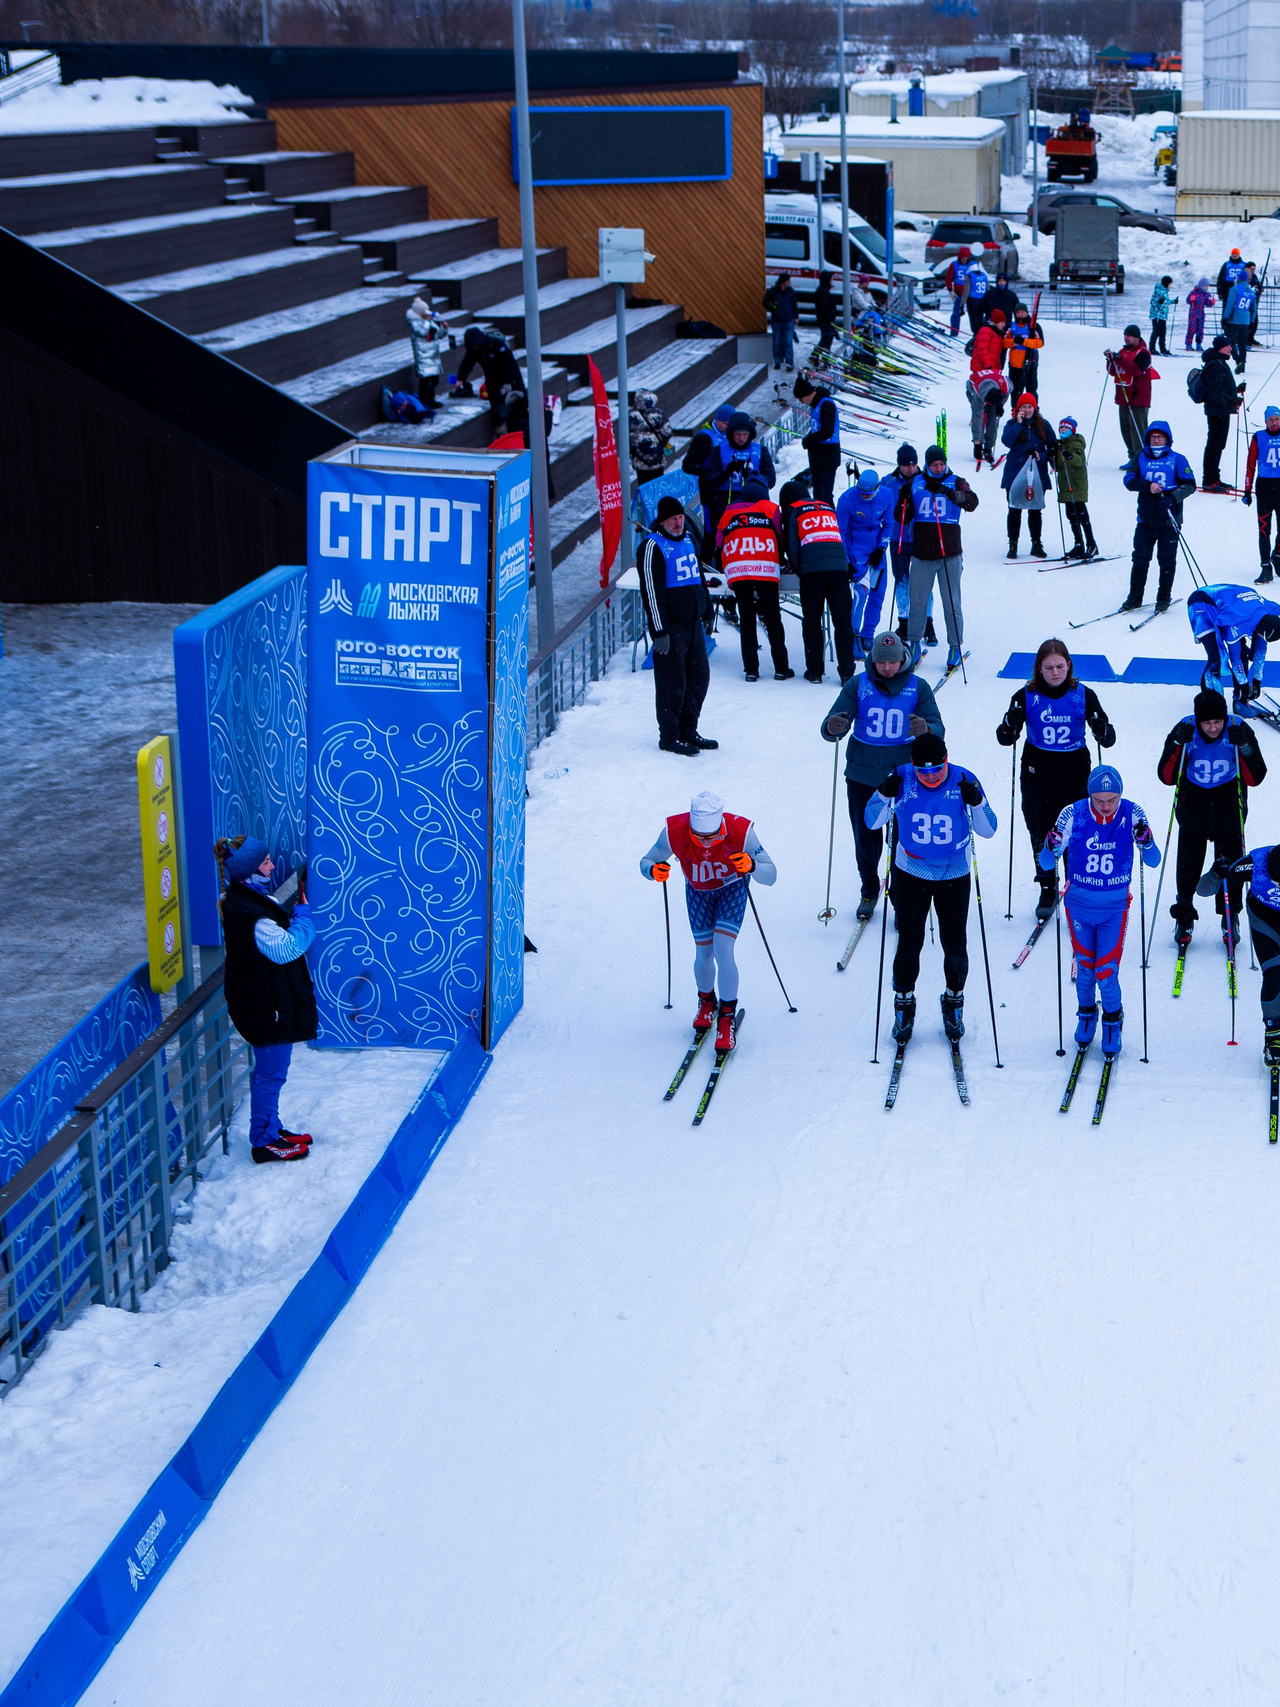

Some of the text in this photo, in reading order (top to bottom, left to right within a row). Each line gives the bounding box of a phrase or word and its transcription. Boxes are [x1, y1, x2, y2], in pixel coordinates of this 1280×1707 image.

[975, 281, 986, 293] 39
[1238, 297, 1251, 310] 64
[918, 496, 946, 518] 49
[320, 491, 481, 565] СТАРТ
[749, 517, 770, 526] Sport
[723, 537, 776, 557] СУДЬЯ
[675, 553, 700, 581] 52
[389, 582, 478, 604] МОСКОВСКАЯ
[388, 602, 440, 621] ЛЫЖНЯ
[336, 639, 460, 659] ЮГО-ВОСТОК
[866, 707, 904, 739] 30
[1042, 725, 1071, 745] 92
[1194, 759, 1230, 784] 32
[911, 812, 953, 845] 33
[692, 860, 728, 883] 102
[1085, 853, 1114, 875] 86
[1073, 873, 1130, 887] ЛЫЖНЯ МОЭК
[1174, 970, 1182, 989] BRADOS
[671, 1068, 685, 1089] FISCHER
[957, 1081, 967, 1097] TRAB
[696, 1091, 709, 1112] FISCHER
[886, 1081, 897, 1102] TRAB
